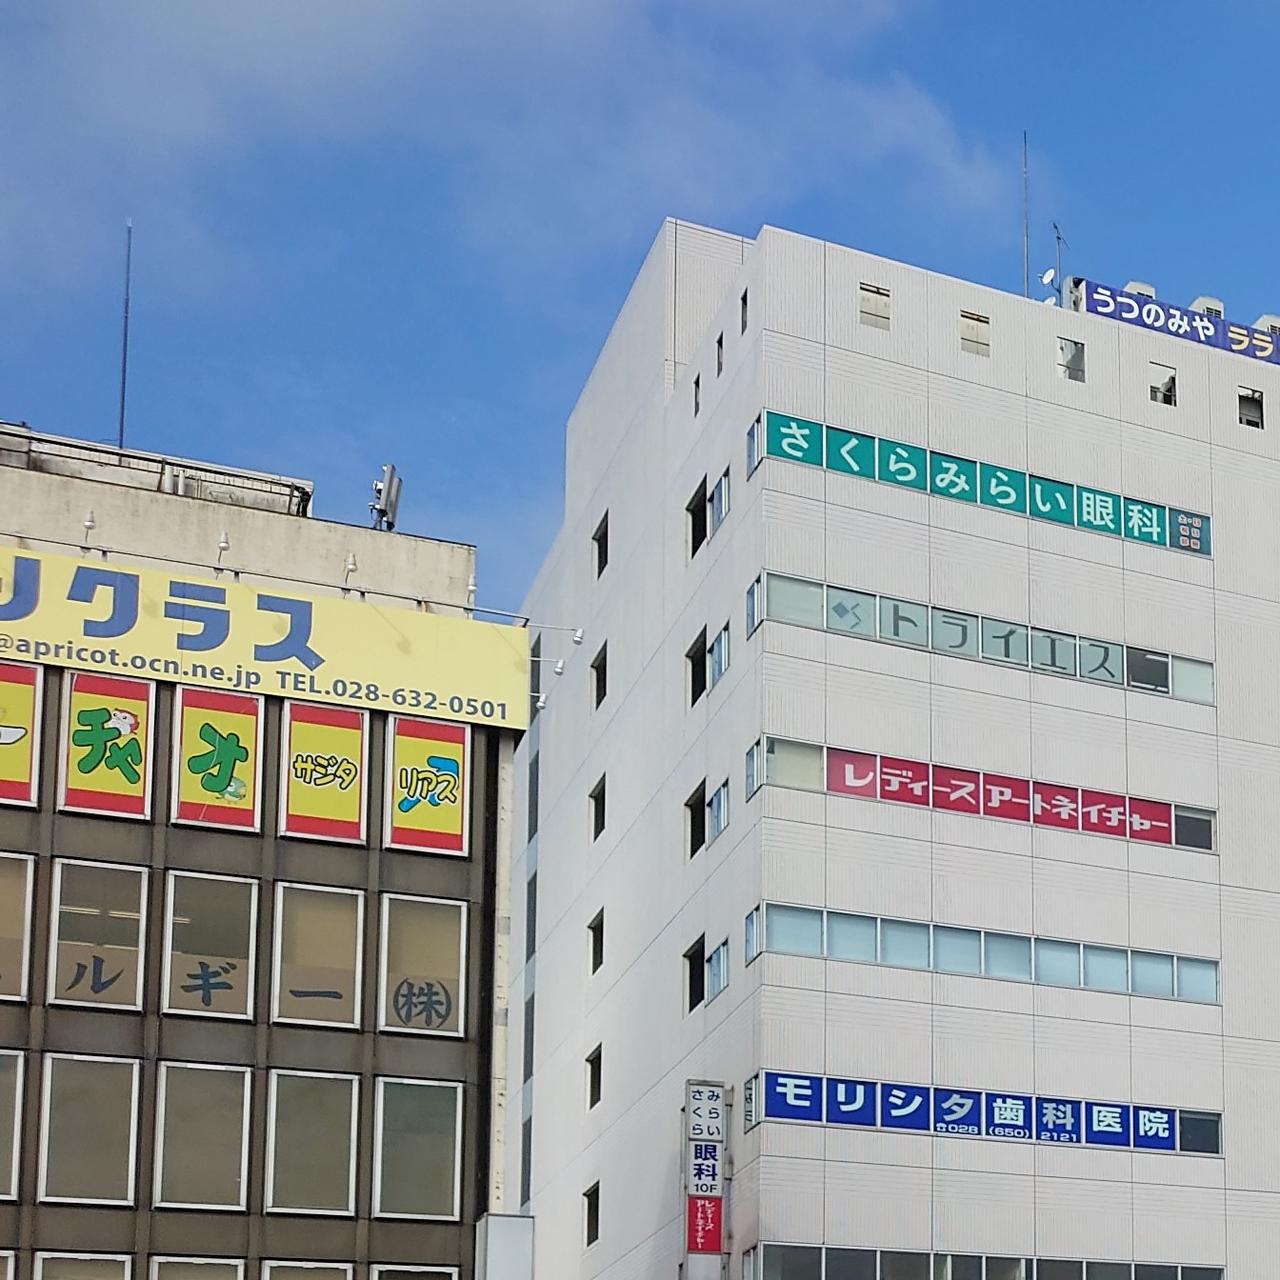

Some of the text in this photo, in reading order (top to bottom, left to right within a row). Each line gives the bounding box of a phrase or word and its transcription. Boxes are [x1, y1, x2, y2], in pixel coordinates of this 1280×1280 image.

[1092, 285, 1215, 340] うつのみや
[778, 421, 1162, 542] さくらみらい眼科
[890, 602, 1117, 678] トライエス
[0, 634, 509, 721] @apricot.ocn.ne.jp TEL.028-632-0501
[691, 1089, 704, 1136] さくら
[707, 1089, 721, 1136] みらい
[774, 1076, 1171, 1139] モリシタ歯科医院
[693, 1144, 719, 1181] 眼科
[693, 1183, 718, 1193] 10F
